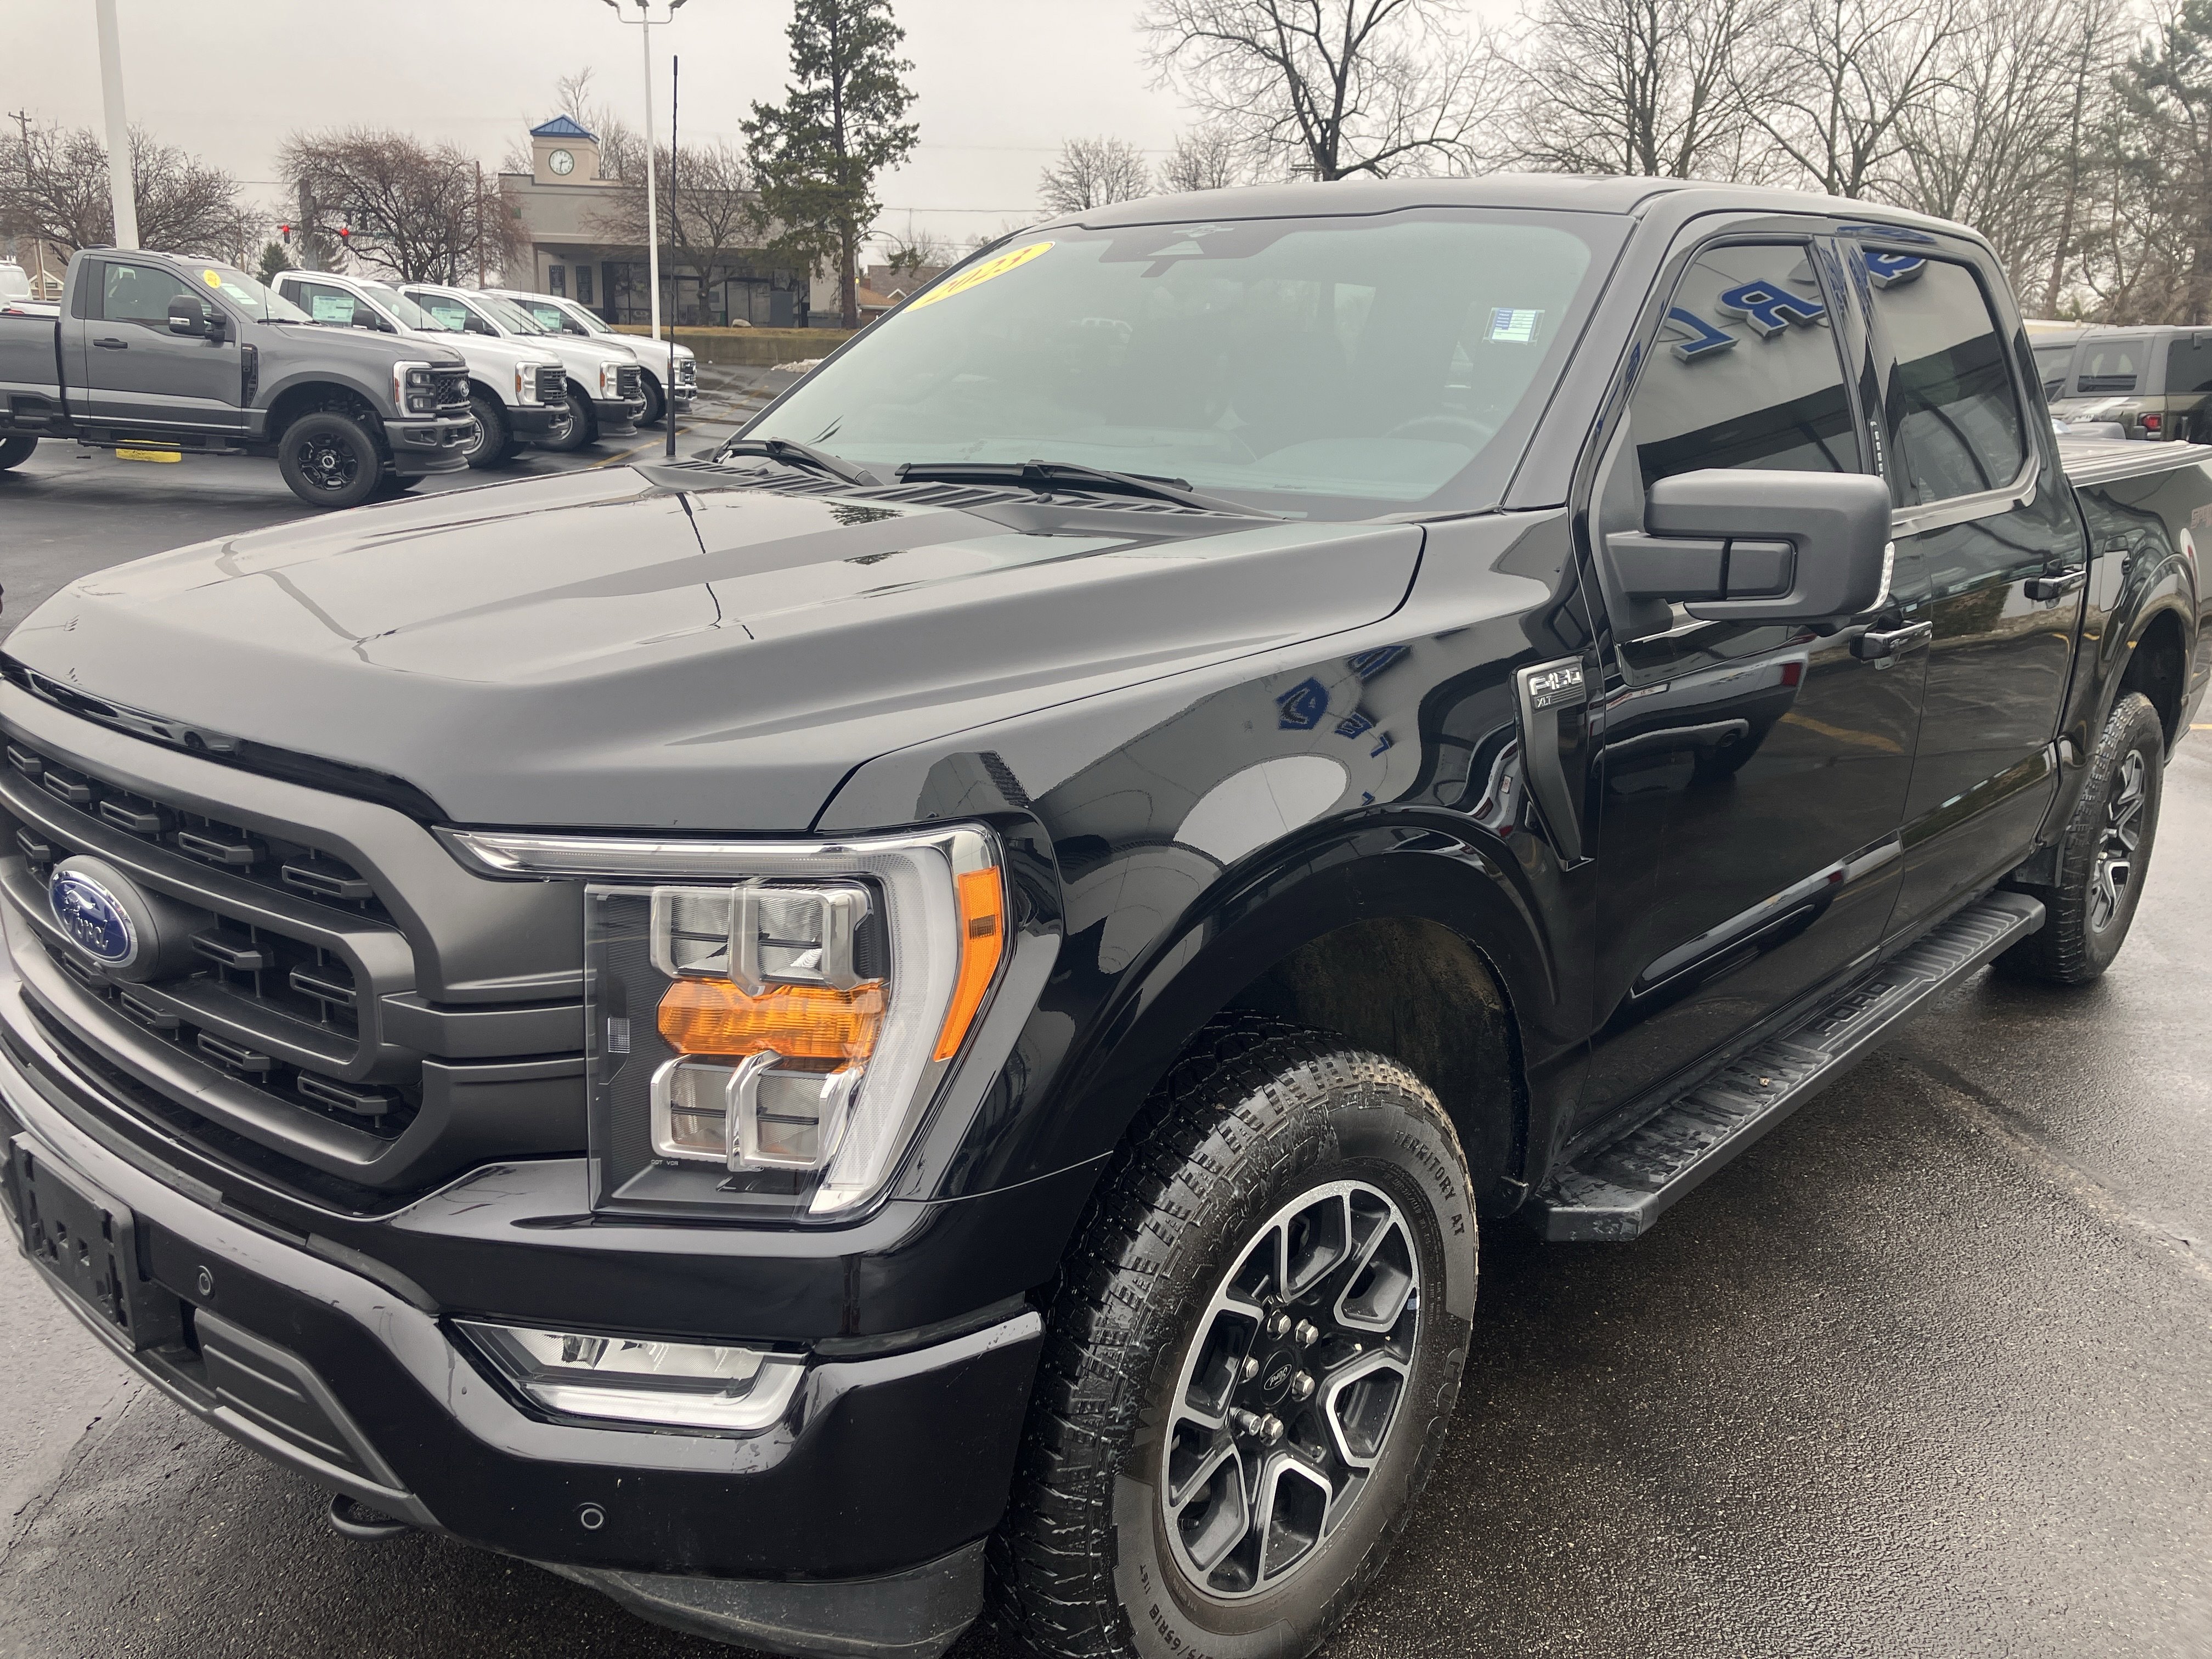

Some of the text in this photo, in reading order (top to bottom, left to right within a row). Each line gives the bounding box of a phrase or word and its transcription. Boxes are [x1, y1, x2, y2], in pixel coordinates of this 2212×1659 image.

[921, 248, 1032, 306] 2023
[1530, 667, 1583, 696] F-150
[1537, 695, 1552, 708] XLT
[62, 889, 109, 951] Ford
[1808, 981, 1897, 1037] FORD
[1392, 1130, 1457, 1201] TERRITORY
[1450, 1213, 1465, 1235] AT
[1269, 1366, 1289, 1387] Ford
[1139, 1564, 1152, 1595] 116T
[1149, 1603, 1214, 1659] 5/65R18
